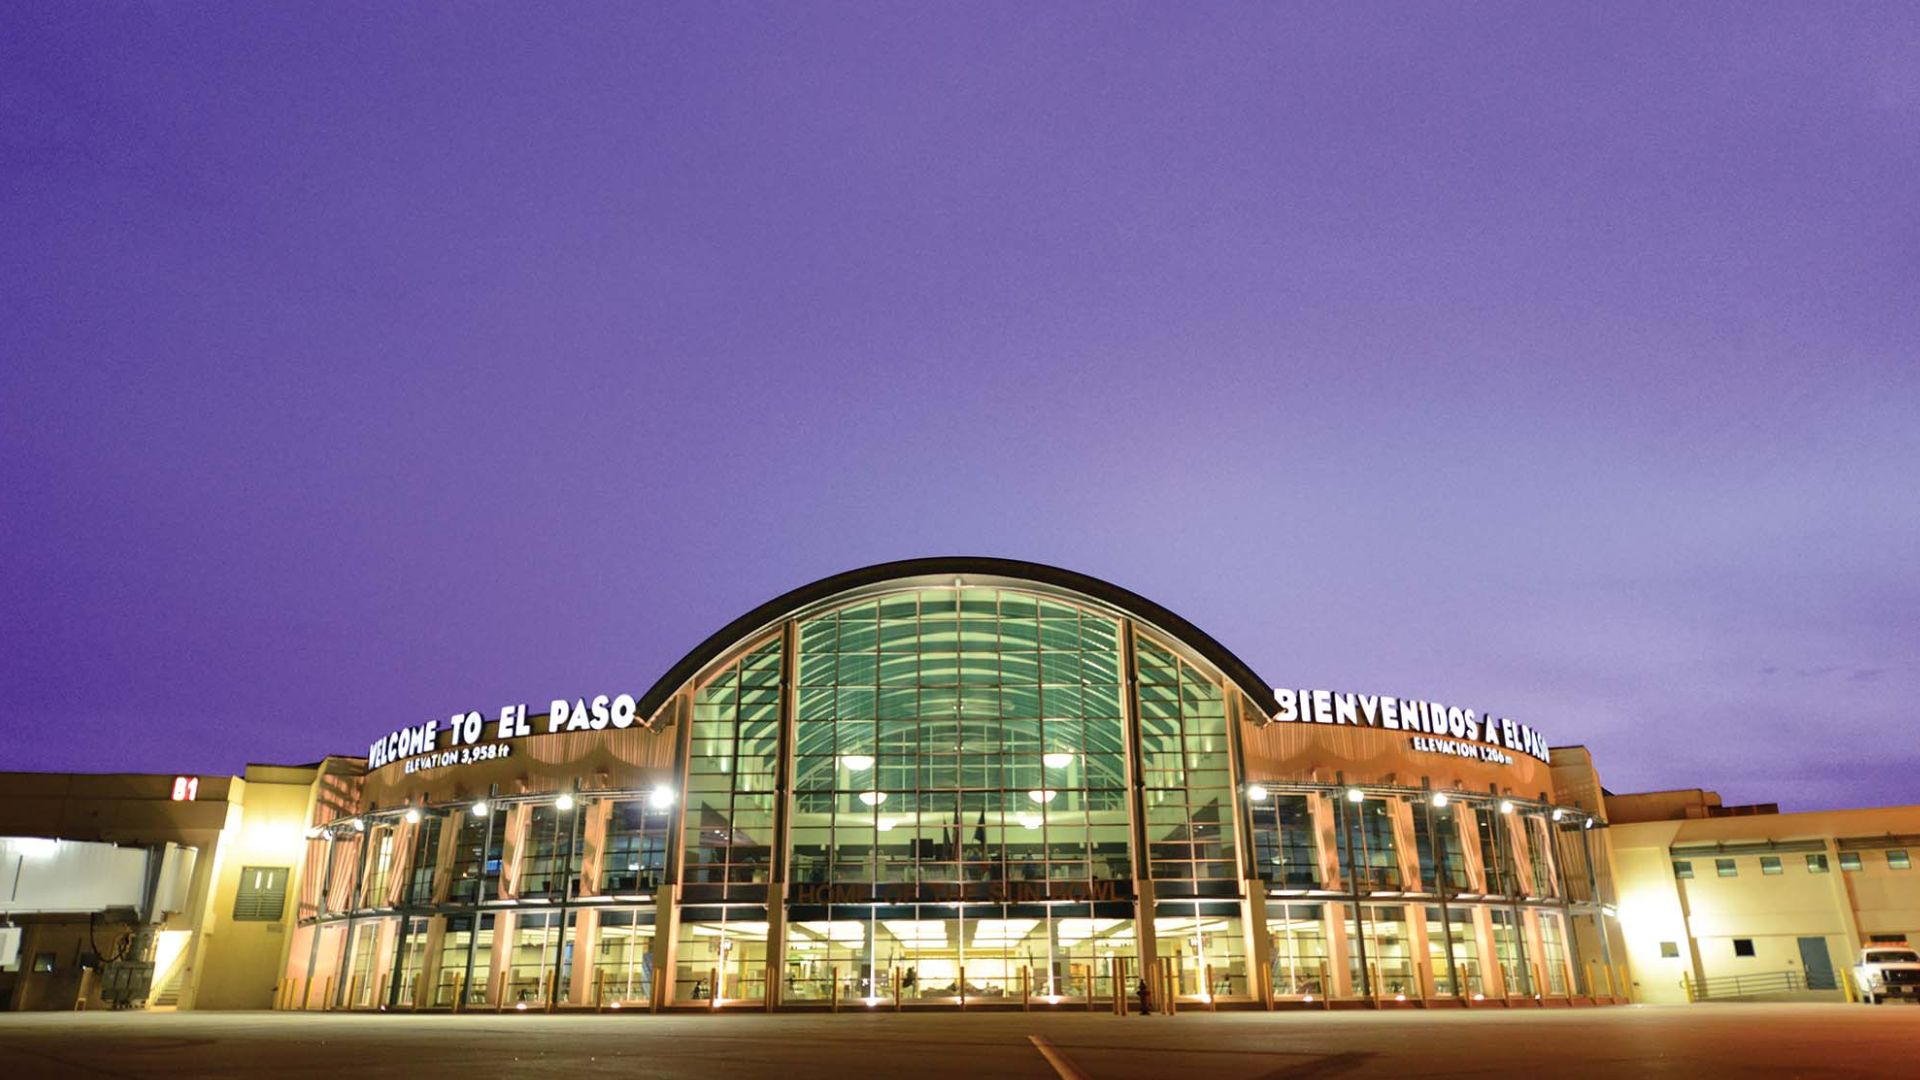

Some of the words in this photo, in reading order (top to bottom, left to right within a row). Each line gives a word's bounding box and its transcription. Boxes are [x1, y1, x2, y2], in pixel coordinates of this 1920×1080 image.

[369, 720, 437, 770] WELCOME
[451, 711, 482, 745] TO
[498, 704, 530, 739] EL
[549, 694, 636, 732] PASO
[1274, 688, 1479, 740] BIENVENIDOS
[1485, 714, 1500, 745] A
[1502, 718, 1523, 751] EL
[405, 750, 458, 774] ELEVATION
[461, 745, 497, 765] 3,958
[498, 743, 510, 758] ft
[1413, 736, 1478, 760] ELEVACION
[798, 884, 866, 904] HOME
